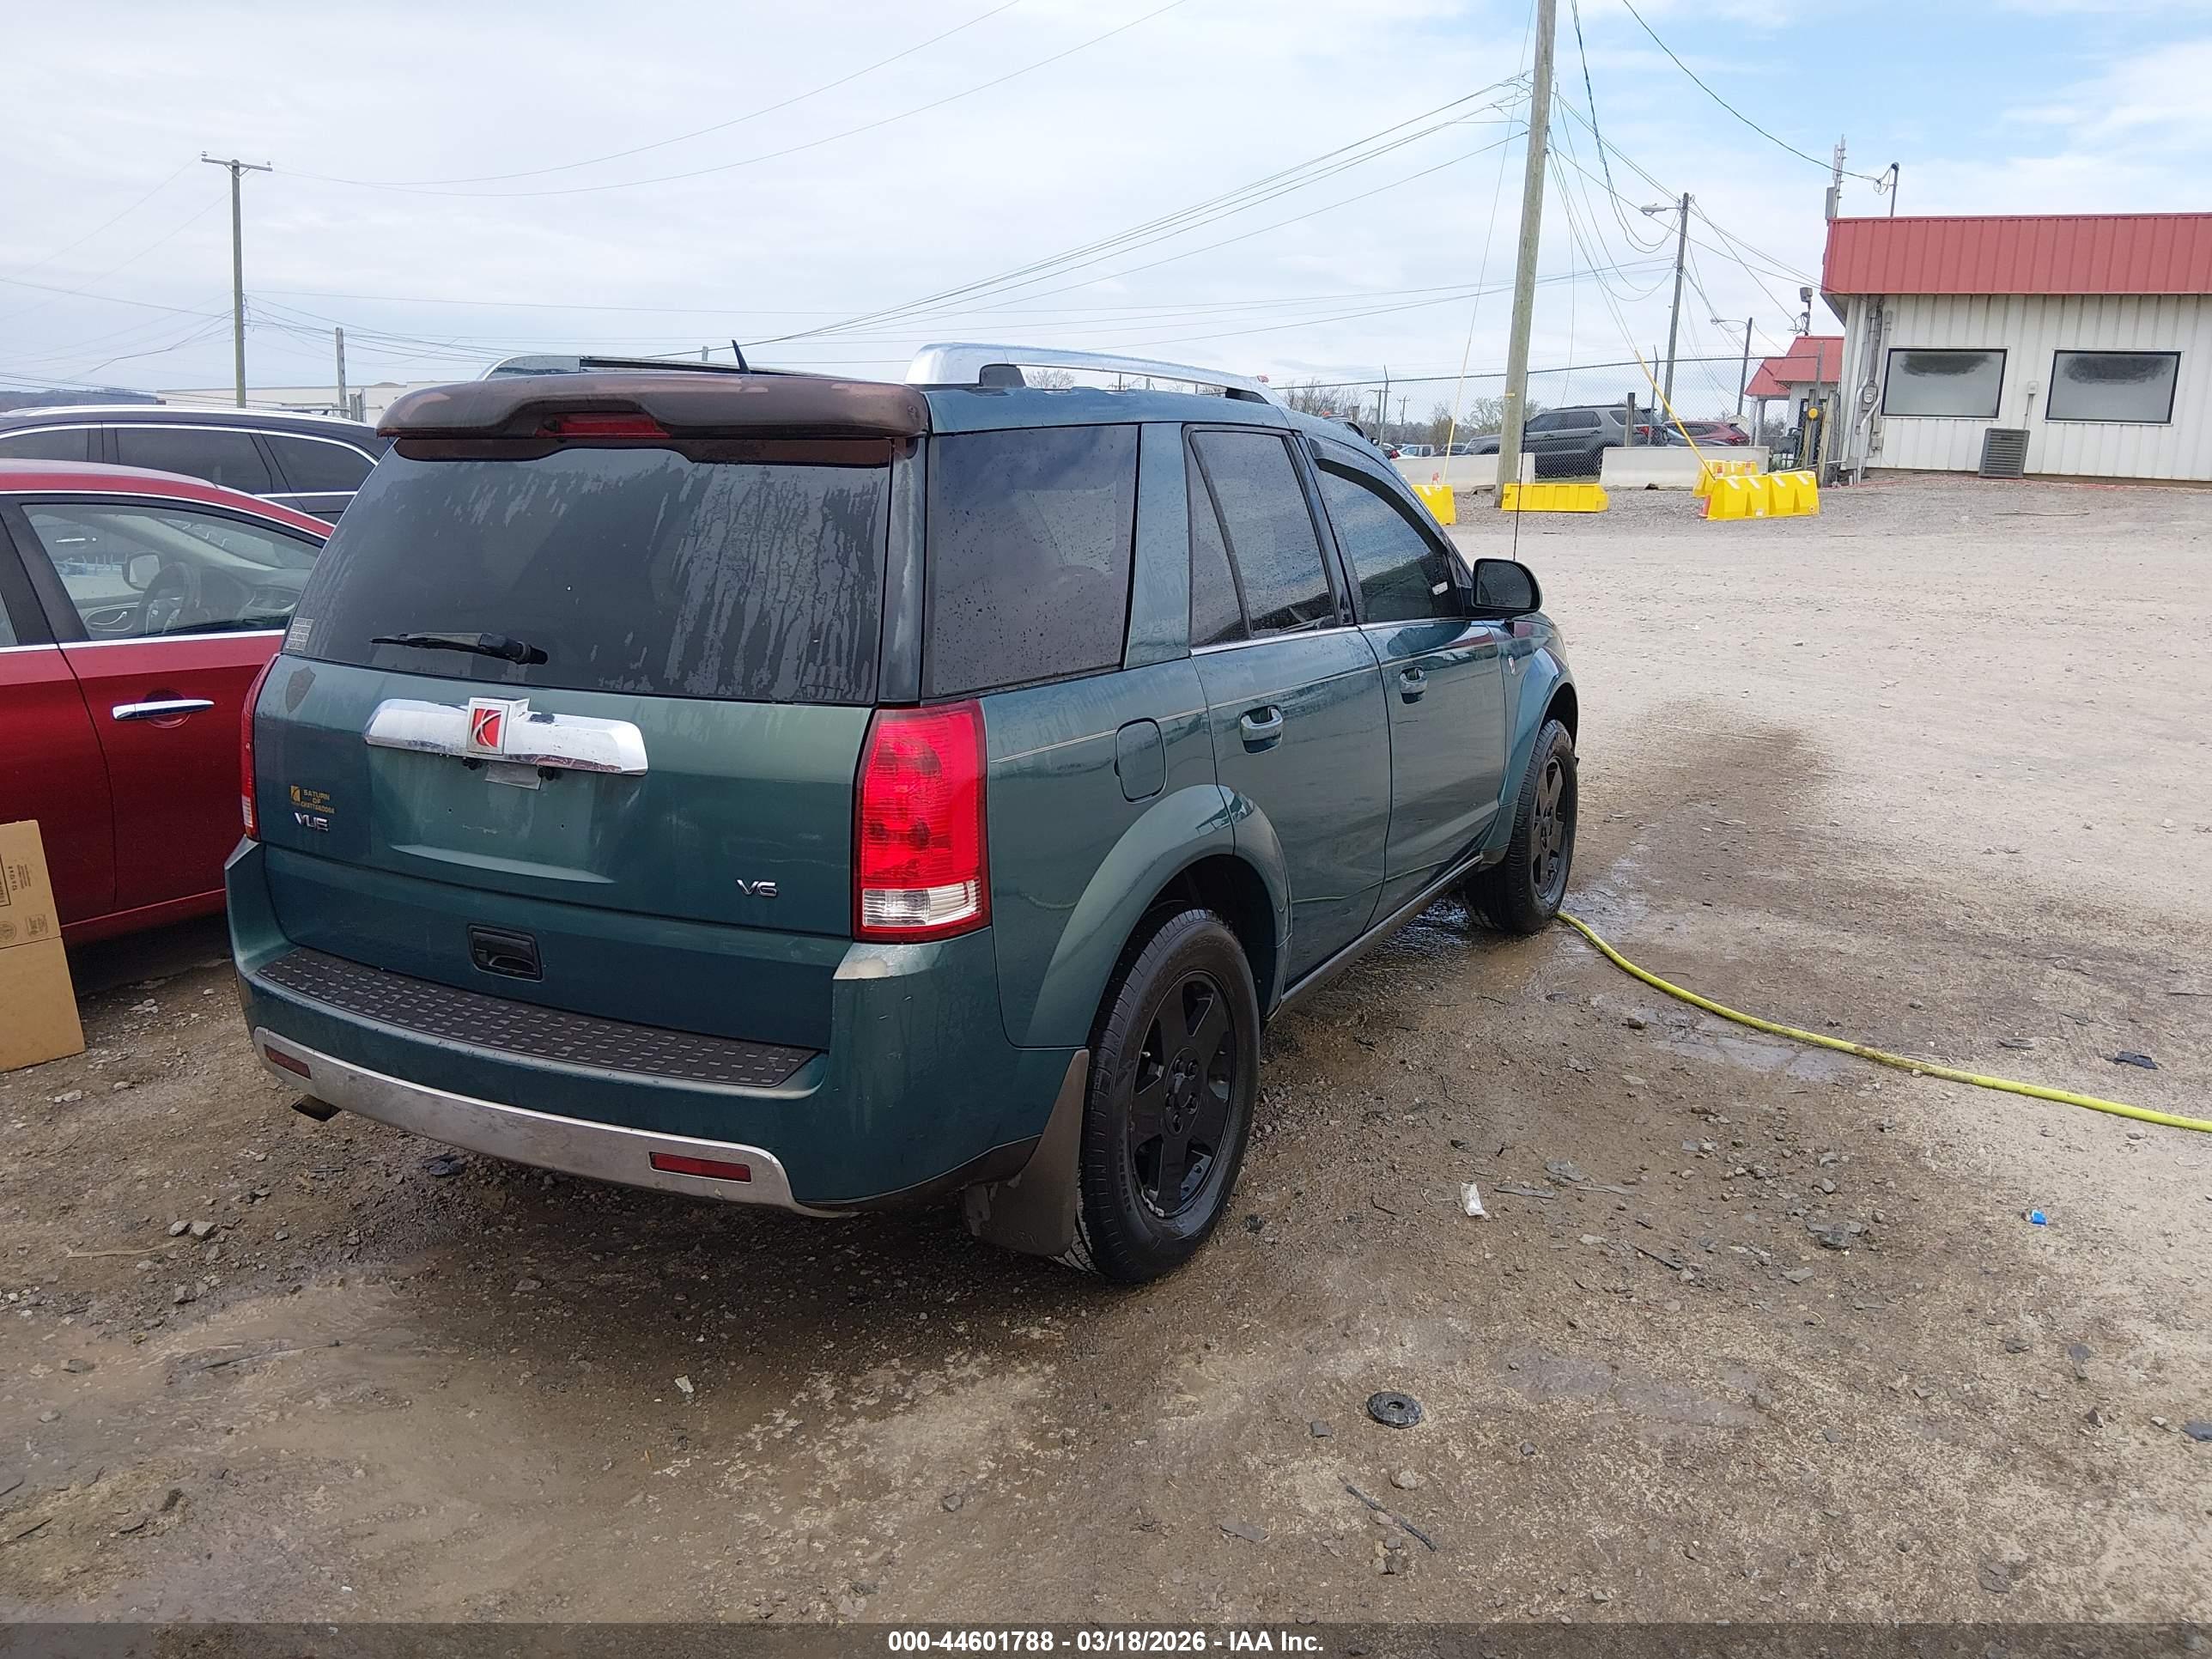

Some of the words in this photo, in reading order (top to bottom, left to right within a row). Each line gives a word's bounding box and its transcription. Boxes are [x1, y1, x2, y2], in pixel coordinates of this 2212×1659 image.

[303, 789, 331, 801] SATURN
[312, 797, 322, 805] OF
[294, 811, 329, 831] VUE
[736, 879, 777, 897] V6
